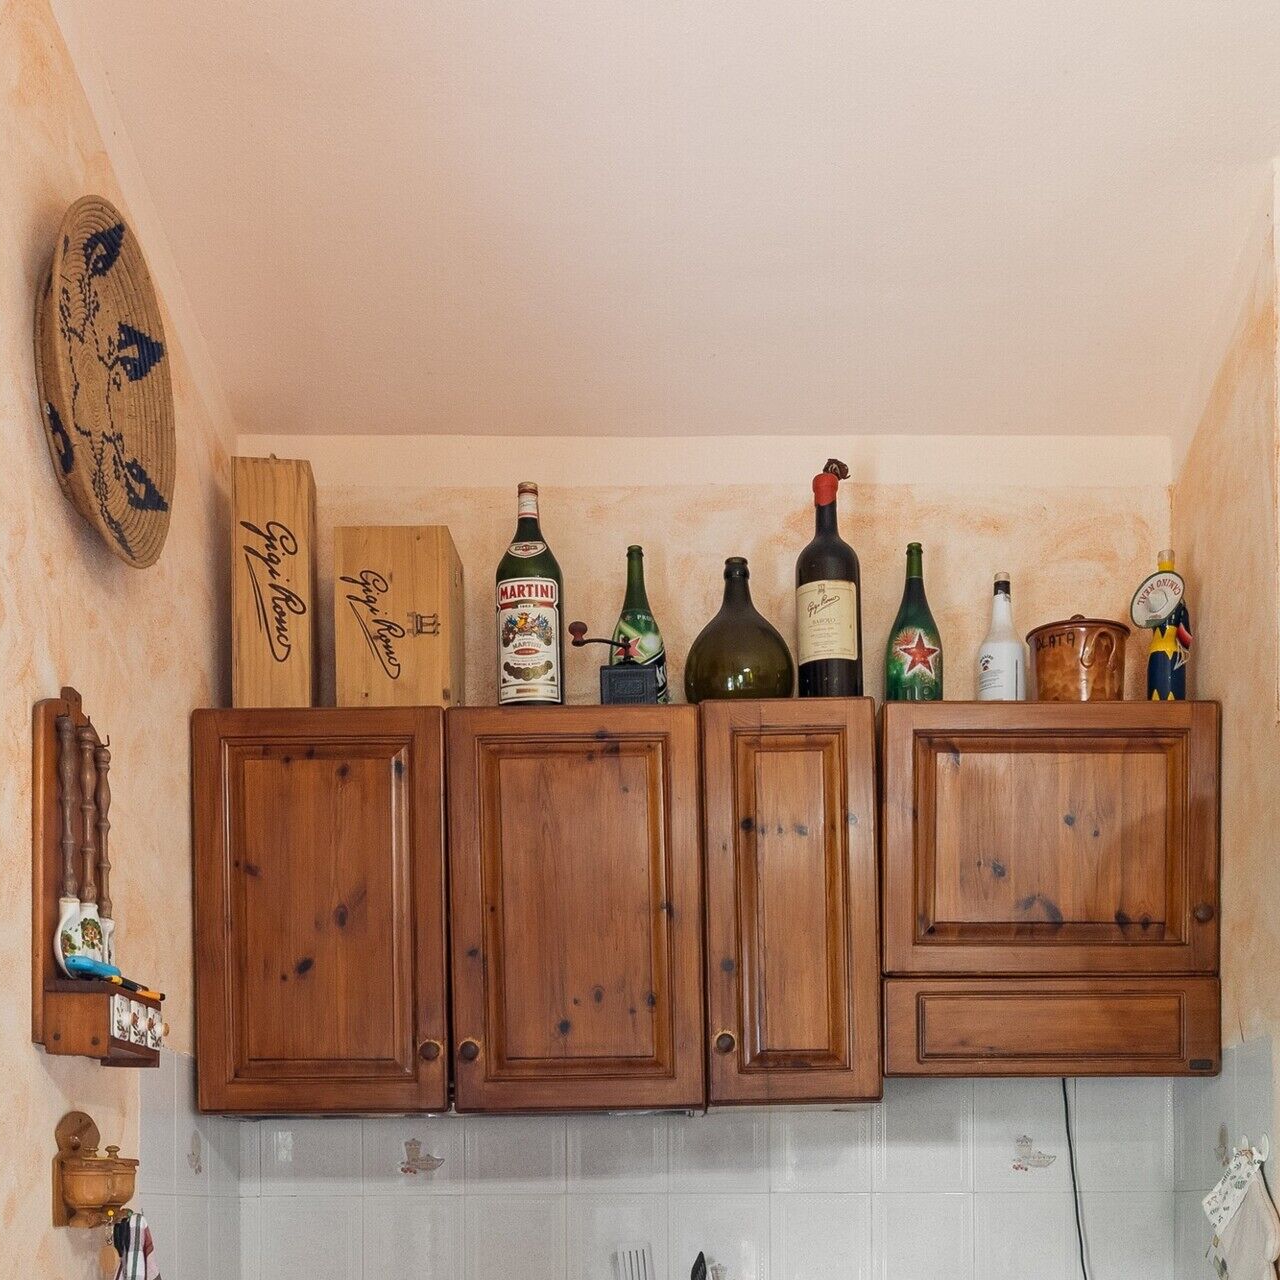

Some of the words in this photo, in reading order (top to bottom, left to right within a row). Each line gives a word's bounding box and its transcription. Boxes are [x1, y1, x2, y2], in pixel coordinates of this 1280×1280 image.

[500, 584, 554, 600] MARTINI
[1137, 585, 1156, 606] REAL
[1156, 578, 1181, 596] CAMINO
